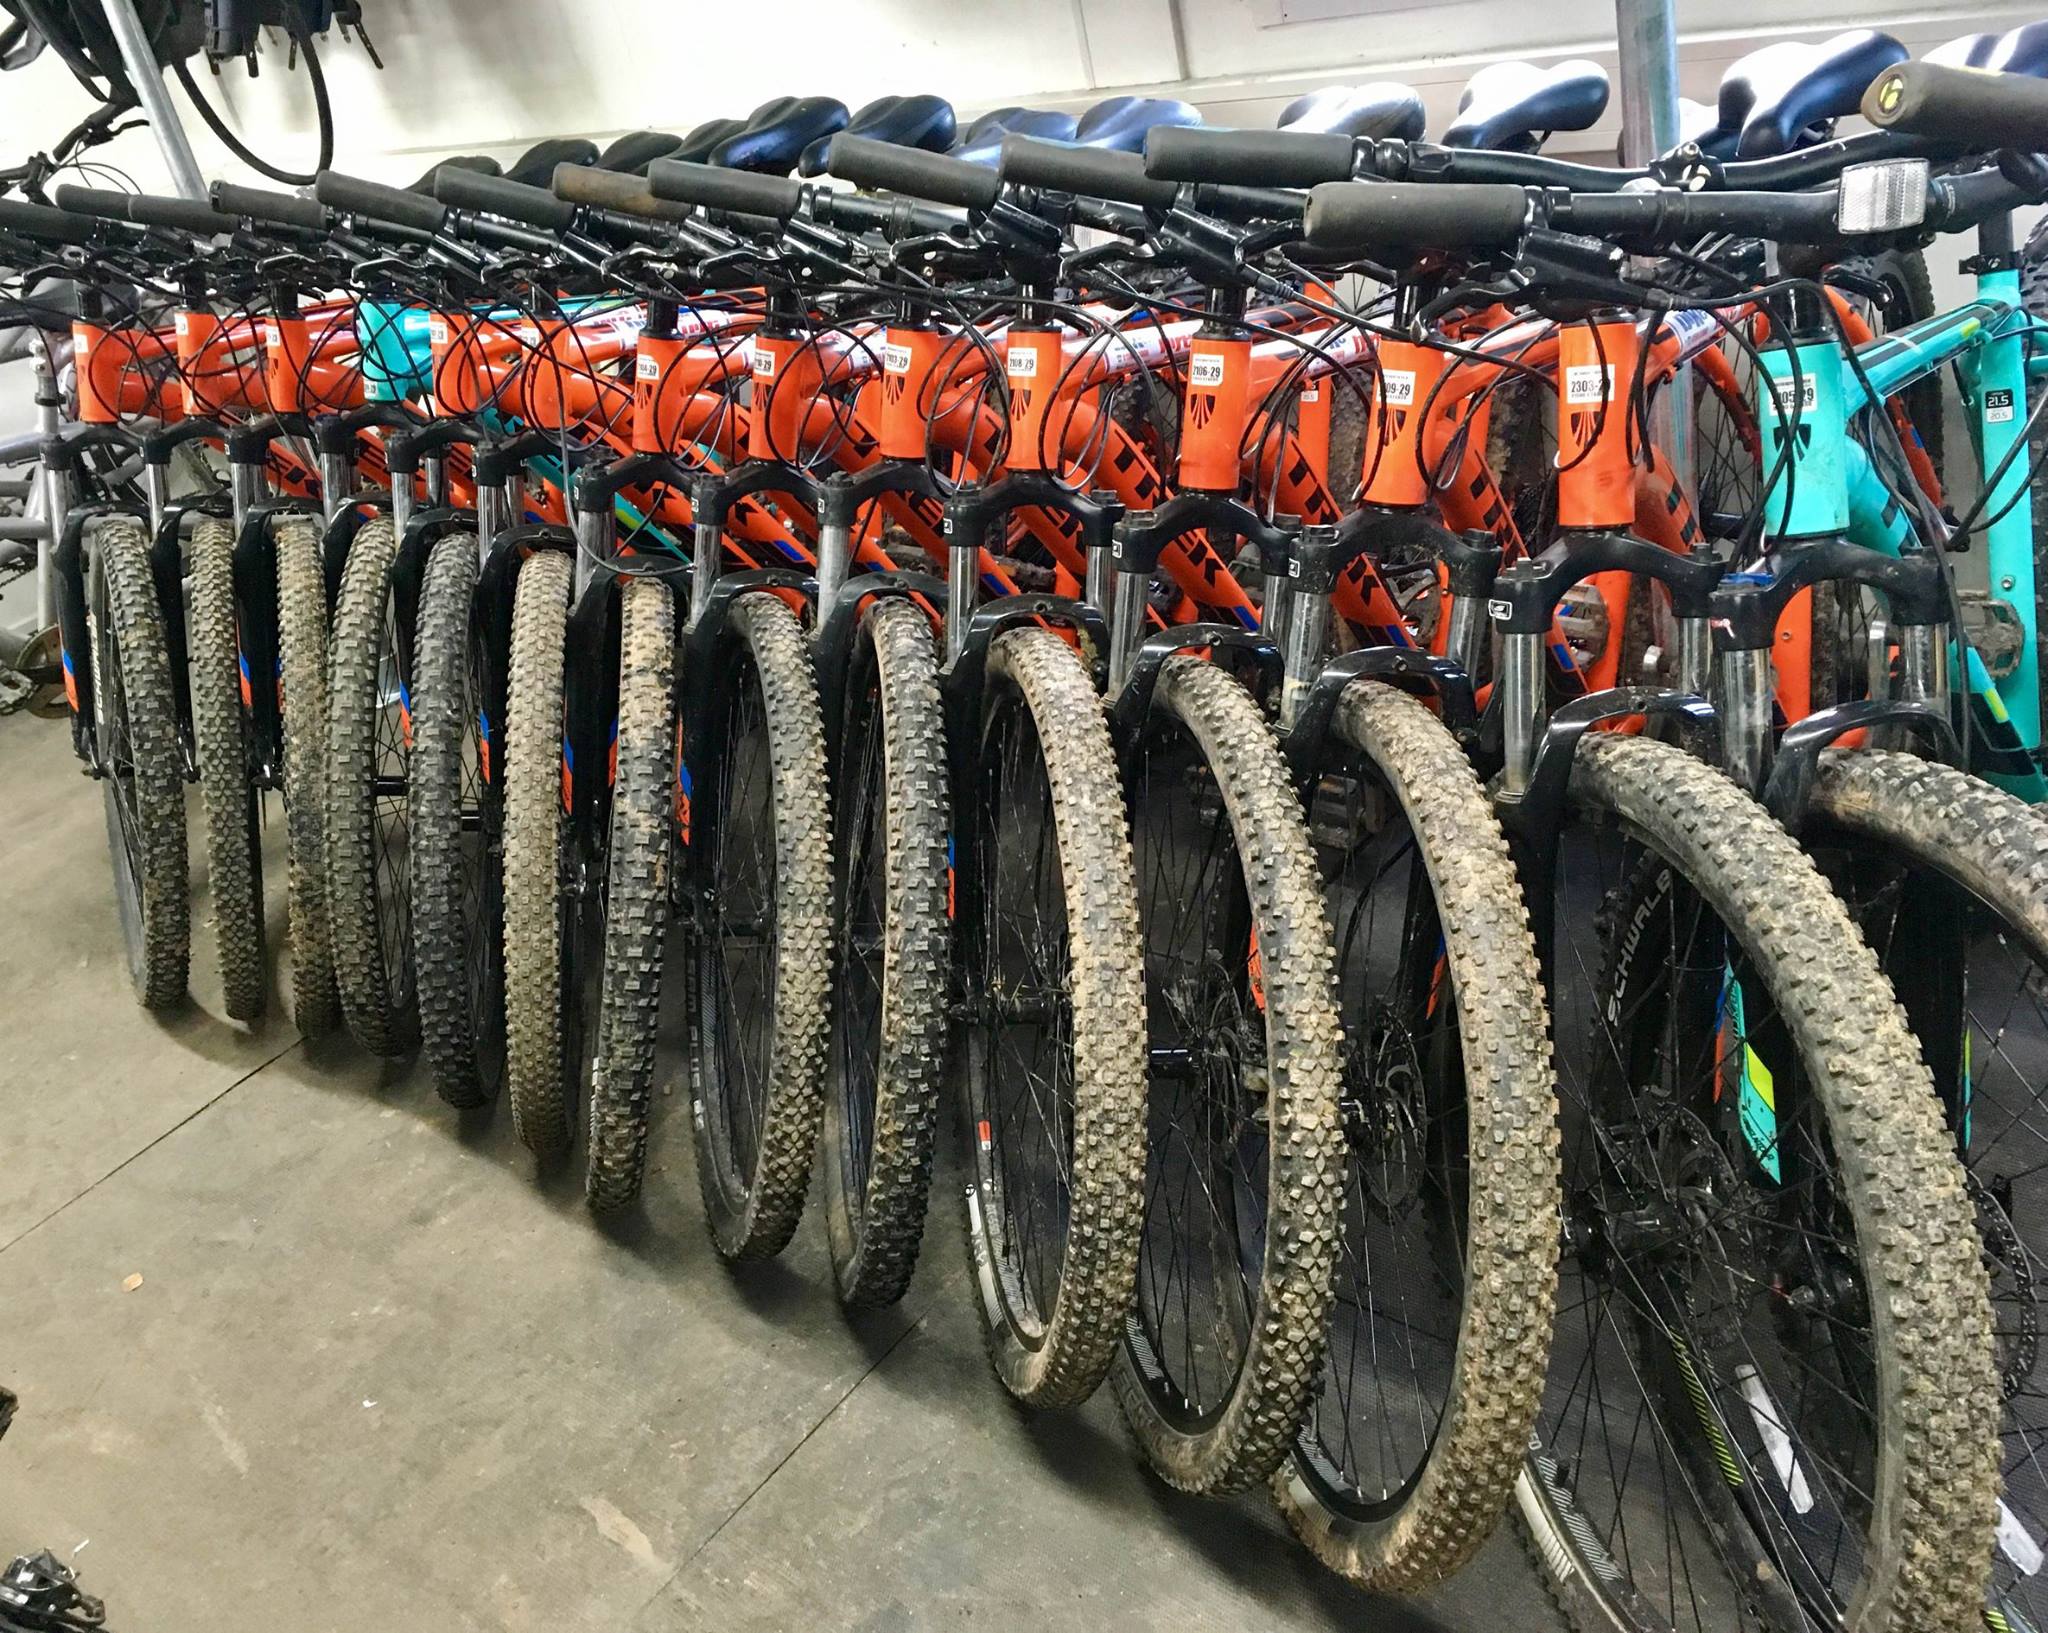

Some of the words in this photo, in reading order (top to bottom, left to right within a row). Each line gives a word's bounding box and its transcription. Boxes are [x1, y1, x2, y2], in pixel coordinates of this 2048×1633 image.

[1379, 382, 1411, 397] 09-29
[1571, 379, 1611, 393] 2303-2
[1988, 395, 2010, 407] 21.5
[1607, 867, 1671, 1028] SCHWALB
